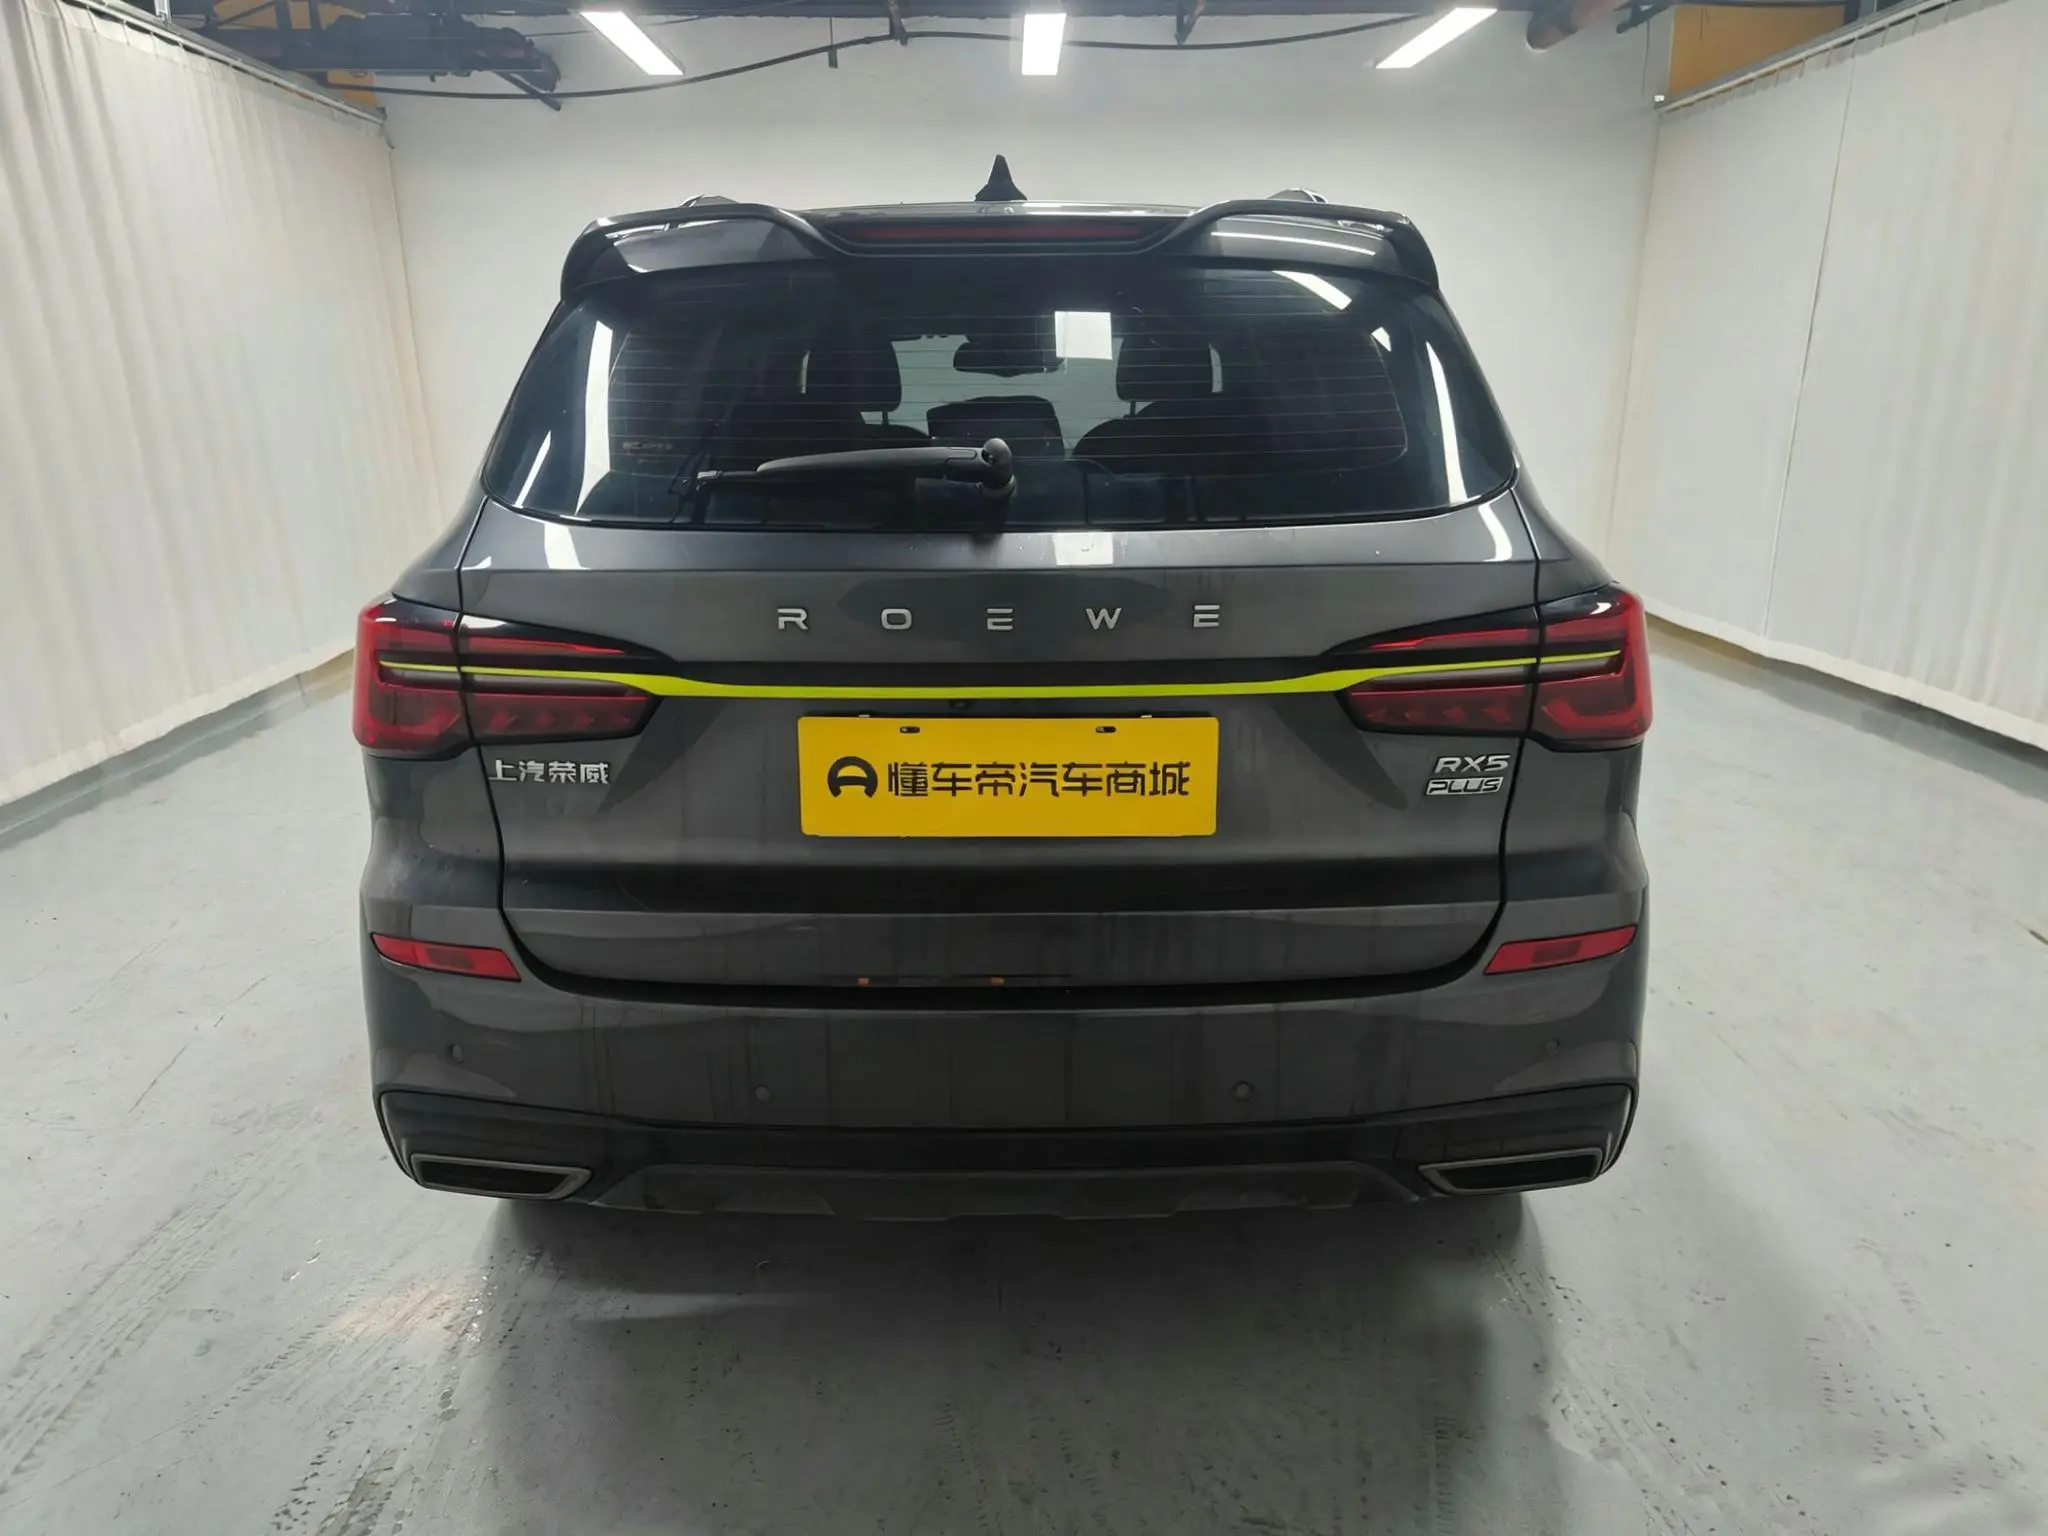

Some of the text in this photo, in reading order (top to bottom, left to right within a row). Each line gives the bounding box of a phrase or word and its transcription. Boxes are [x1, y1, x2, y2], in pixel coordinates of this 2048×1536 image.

[776, 604, 1221, 631] ROEWE
[489, 759, 609, 784] 上汽荣威
[1434, 754, 1511, 774] RX5
[887, 761, 1191, 798] 懂车帝汽车商城
[1425, 776, 1504, 795] PLUS
